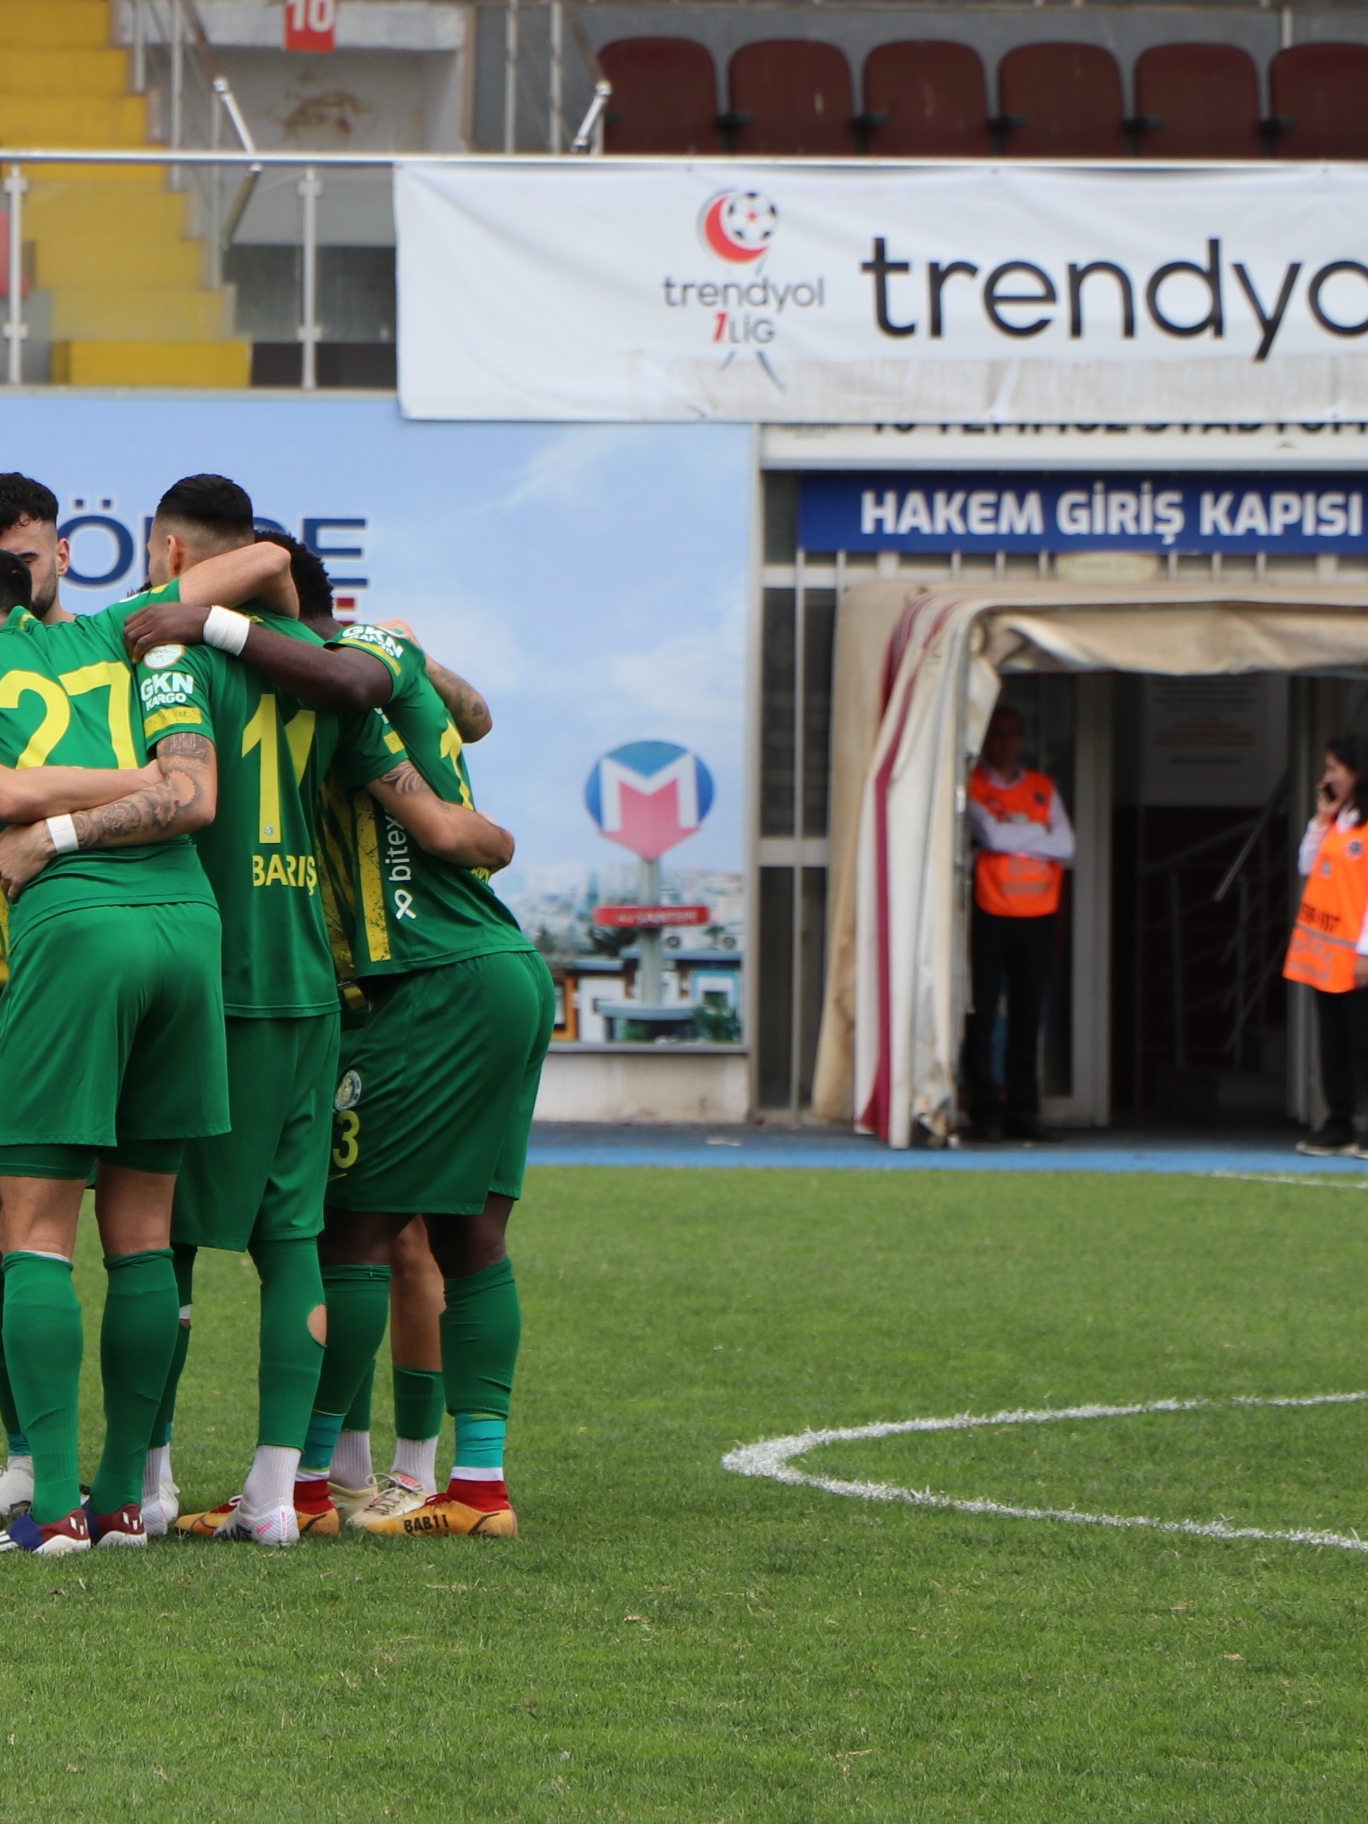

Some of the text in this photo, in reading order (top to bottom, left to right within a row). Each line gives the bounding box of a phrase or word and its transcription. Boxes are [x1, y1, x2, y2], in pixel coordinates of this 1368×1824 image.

[283, 0, 334, 32] 10
[664, 277, 825, 315] trendyol
[860, 481, 1362, 545] HAKEM GİRİŞ KAPISI
[140, 672, 194, 702] GKN
[146, 692, 187, 711] KARGO
[252, 854, 317, 896] BARIŞ
[332, 1109, 360, 1168] 3
